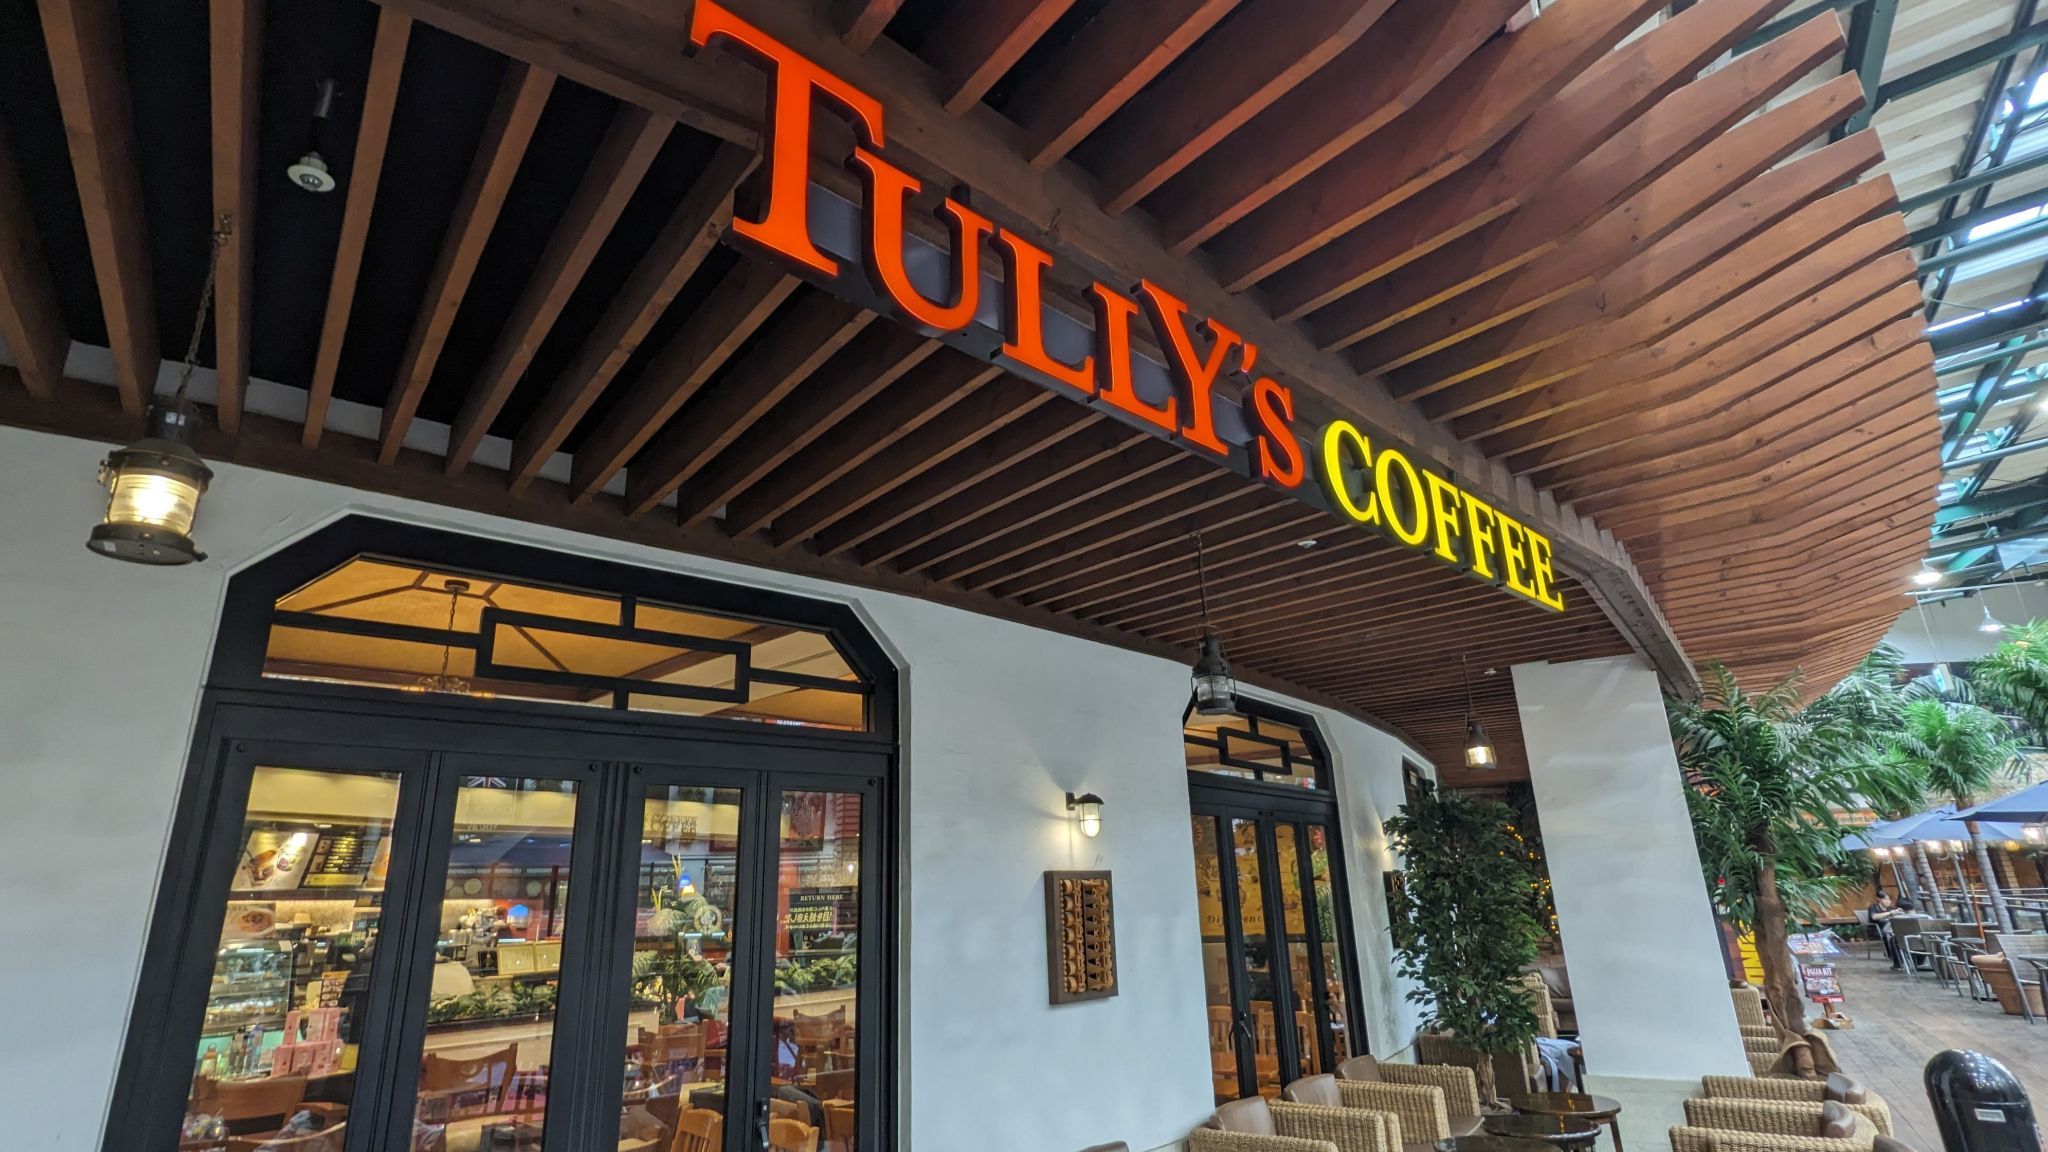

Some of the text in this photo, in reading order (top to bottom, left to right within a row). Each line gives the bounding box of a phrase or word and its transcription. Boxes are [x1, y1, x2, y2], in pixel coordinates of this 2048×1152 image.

[1322, 420, 1564, 612] COFFEE
[800, 894, 825, 902] RETURN
[1807, 967, 1833, 976] PIZZA KIT
